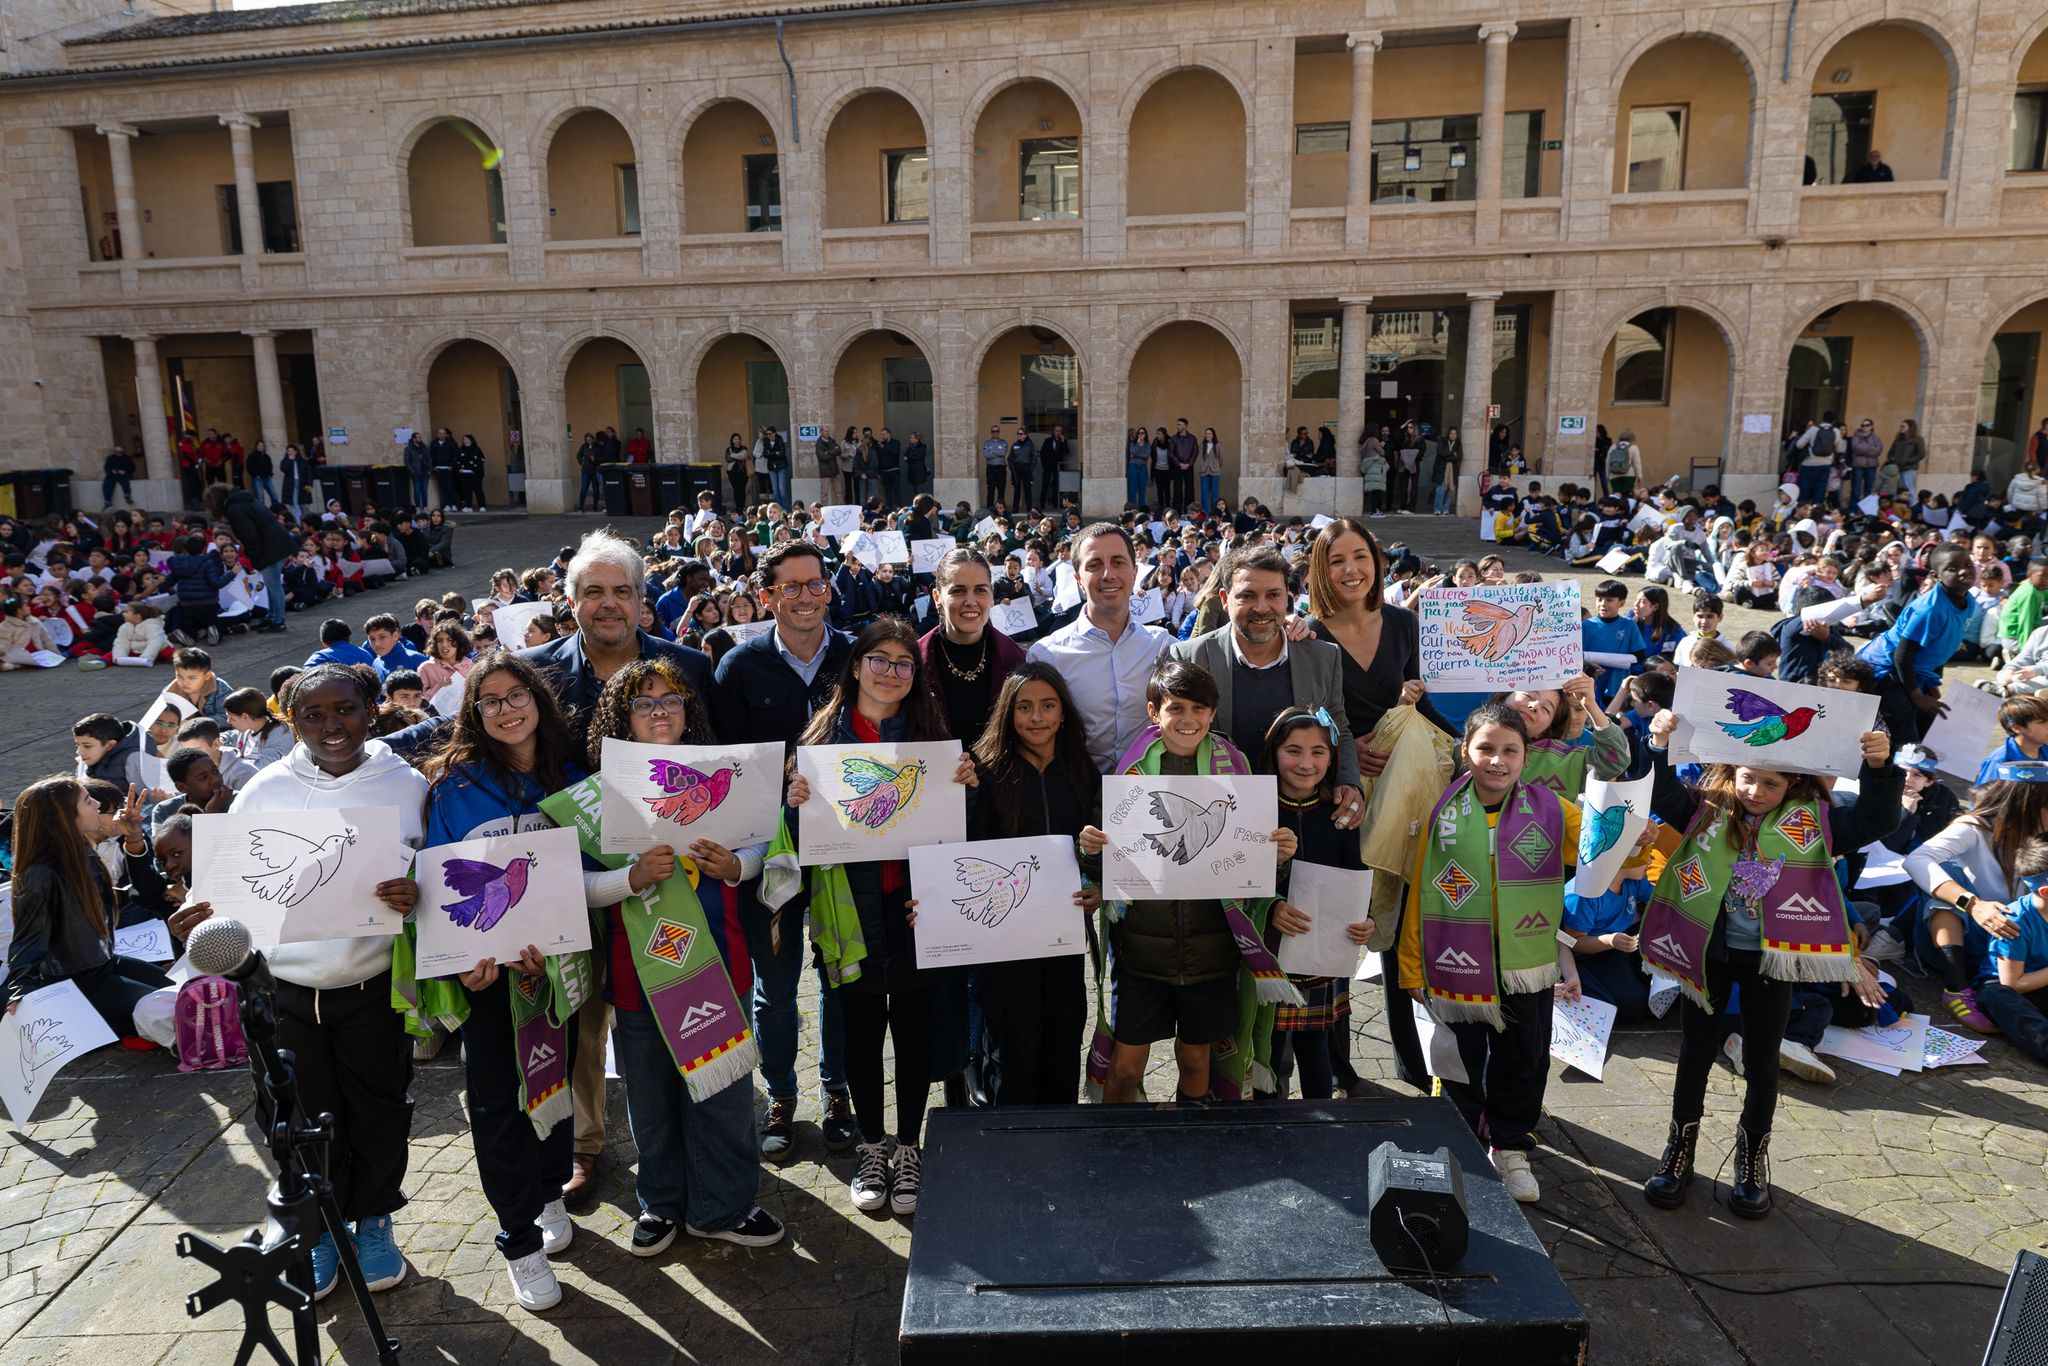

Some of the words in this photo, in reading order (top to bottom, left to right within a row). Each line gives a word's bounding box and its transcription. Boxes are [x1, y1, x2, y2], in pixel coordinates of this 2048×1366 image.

[1109, 785, 1145, 825] PEACE
[574, 814, 595, 839] DESDE
[1233, 827, 1268, 844] PACE
[1438, 799, 1457, 852] SAL
[1210, 850, 1246, 876] PAZ
[1776, 911, 1832, 922] conectabalear
[1435, 965, 1481, 975] conectabalear
[680, 1009, 727, 1040] conectabalear
